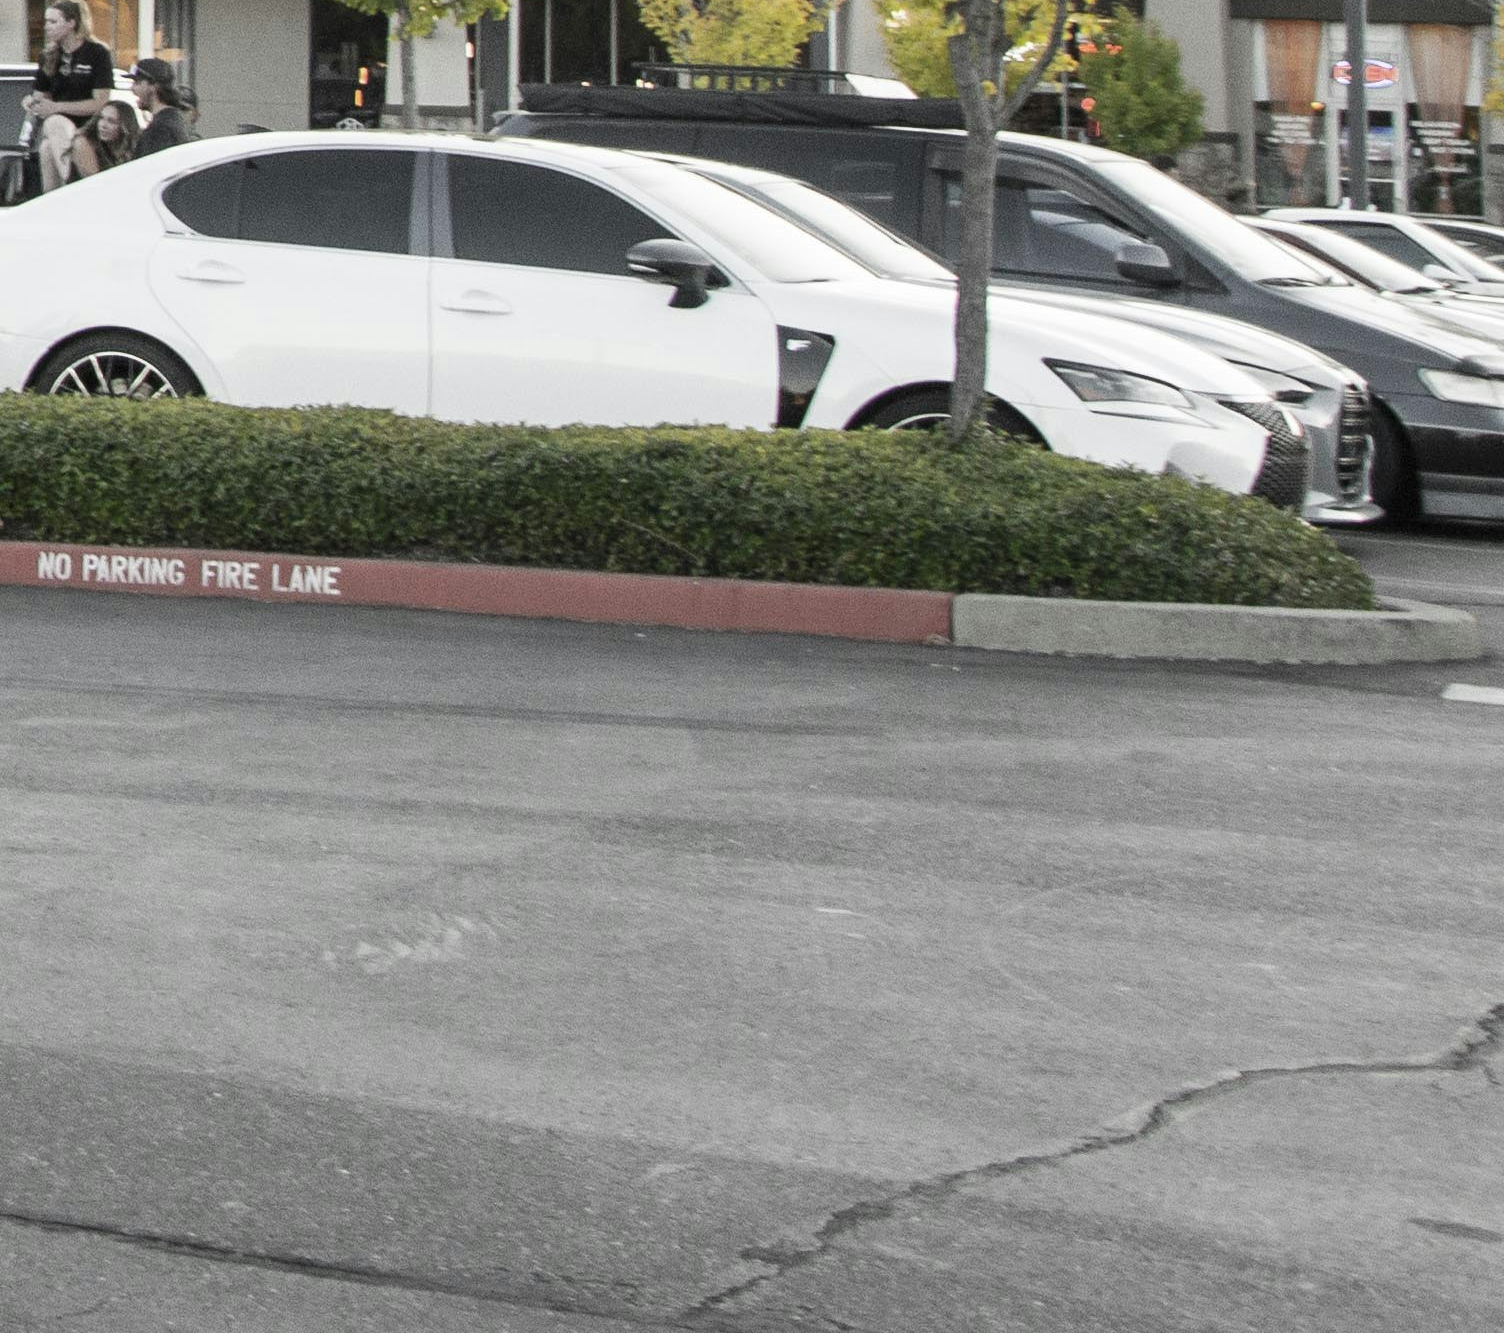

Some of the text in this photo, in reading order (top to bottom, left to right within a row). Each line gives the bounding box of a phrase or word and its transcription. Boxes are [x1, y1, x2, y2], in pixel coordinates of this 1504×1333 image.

[38, 551, 342, 596] NO PARKING FIRE LANE
